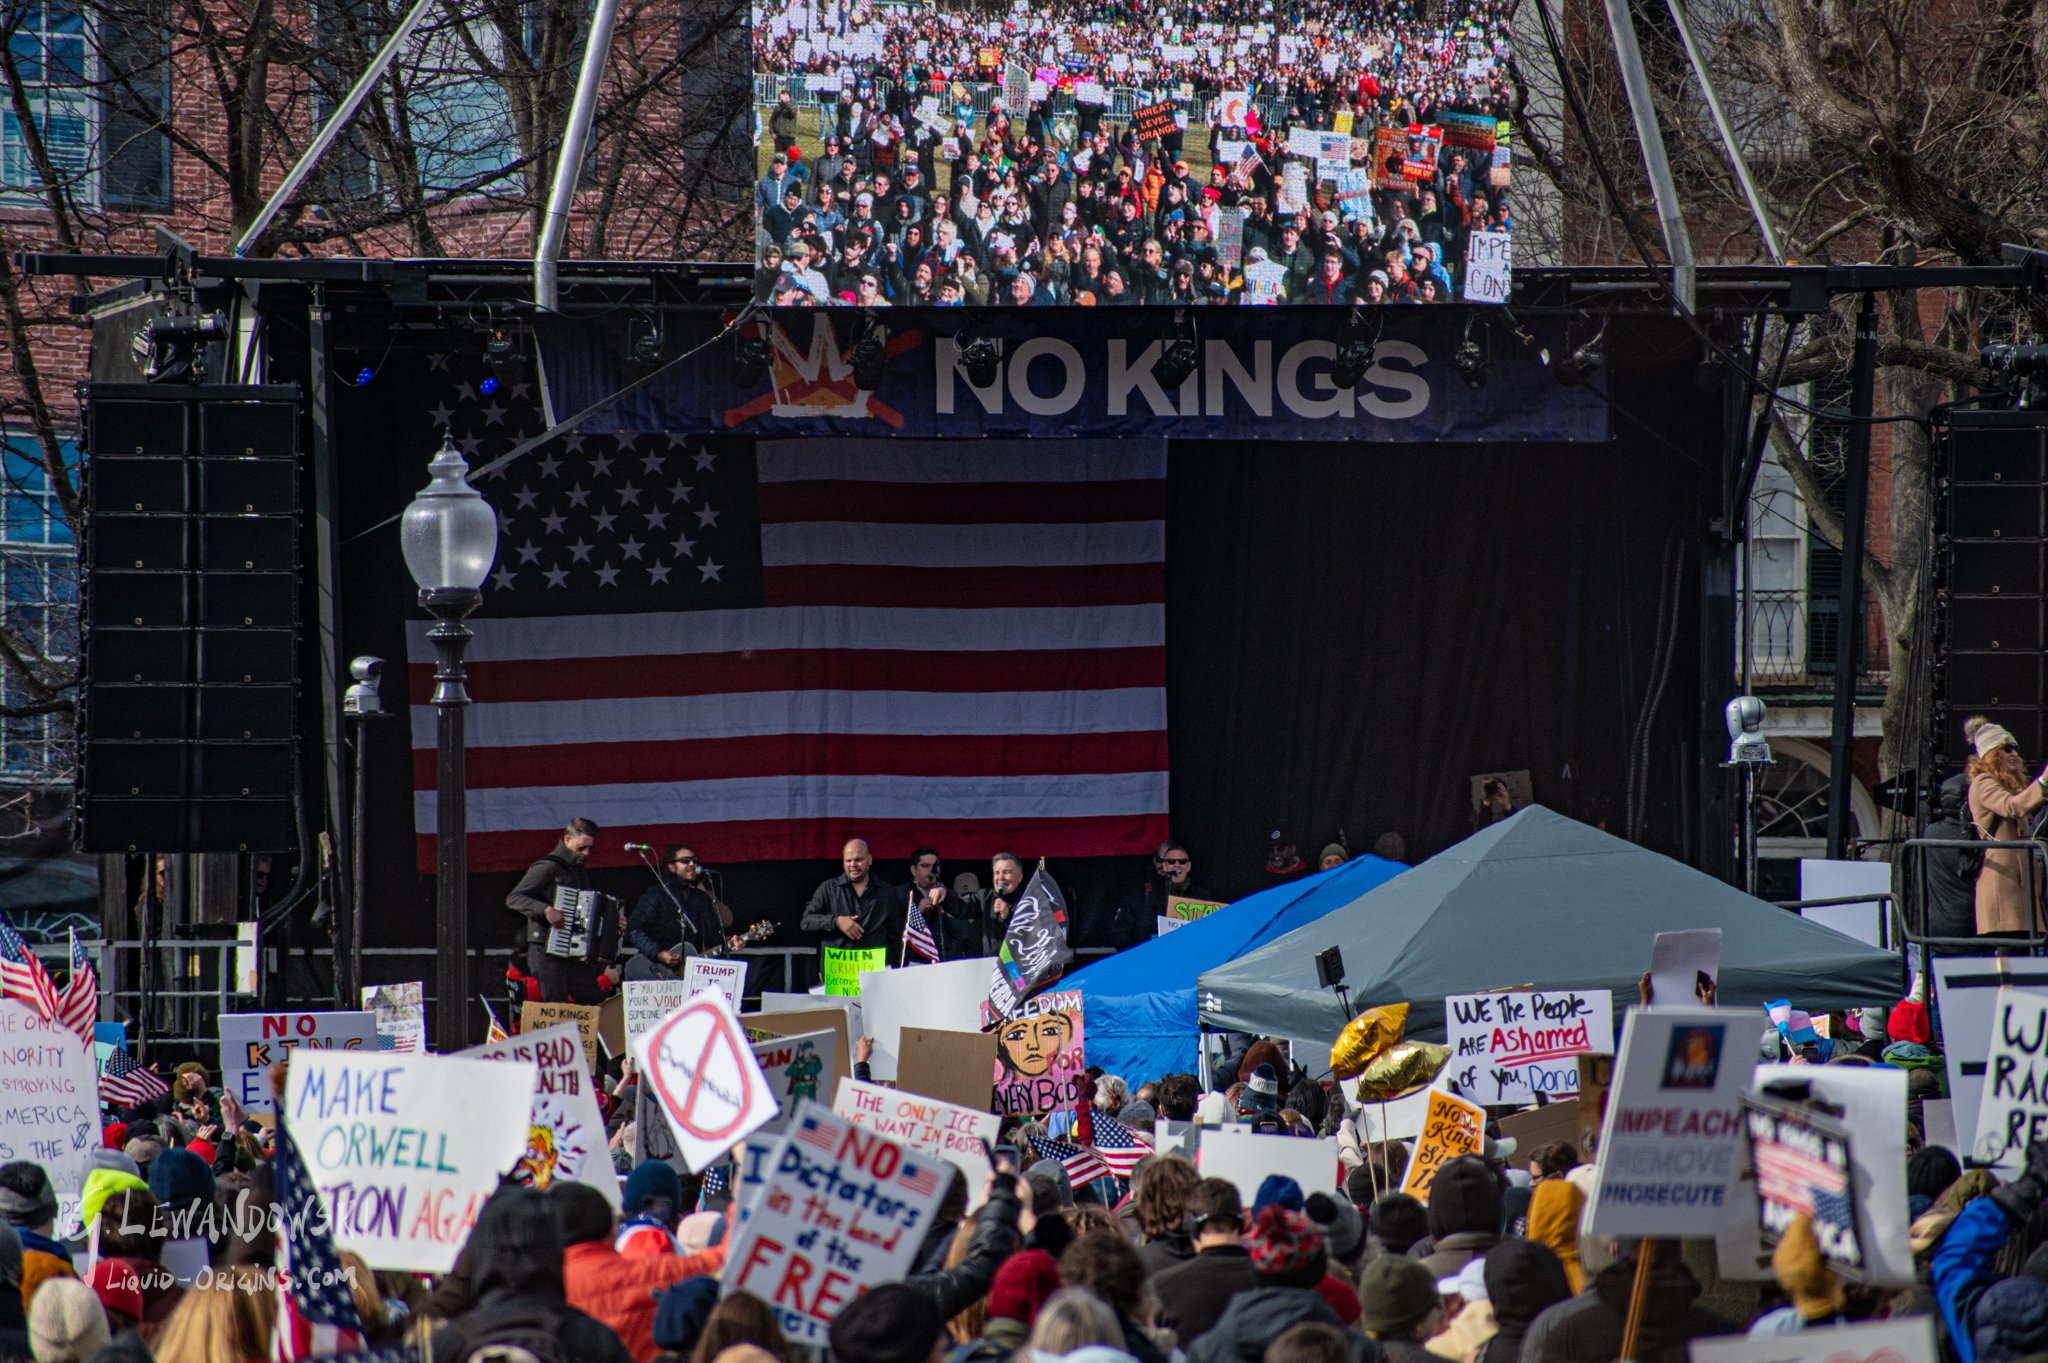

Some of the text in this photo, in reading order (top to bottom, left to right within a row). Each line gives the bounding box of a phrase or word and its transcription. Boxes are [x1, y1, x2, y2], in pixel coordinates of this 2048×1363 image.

[1133, 102, 1172, 119] THREAT
[1140, 115, 1170, 129] LEVEL
[1139, 123, 1178, 142] ORANGE
[1471, 270, 1511, 298] CON
[935, 337, 1430, 419] NO KINGS
[1175, 902, 1221, 921] STA
[827, 949, 873, 962] WHEN
[695, 964, 736, 977] TRUMP
[627, 983, 636, 995] IF
[640, 983, 653, 994] YOU
[628, 996, 649, 1006] YOUR
[540, 1007, 590, 1020] NO KINGS
[628, 1009, 661, 1020] SOMEONE
[1454, 993, 1593, 1026] WE The People
[24, 1014, 69, 1036] ONL
[262, 1015, 316, 1039] NO
[1458, 1017, 1591, 1057] ARE Ashamed
[2003, 1004, 2048, 1057] W
[535, 1037, 575, 1069] BAD
[1045, 1047, 1083, 1075] FOR
[297, 1066, 405, 1119] MAKE
[851, 1088, 979, 1135] THE ONLY ICE
[1612, 1106, 1743, 1137] IMPEACH
[873, 1117, 918, 1138] WANT
[920, 1125, 942, 1144] IN
[1425, 1120, 1480, 1153] Kings
[28, 1139, 64, 1161] THE
[316, 1121, 460, 1174] ORWELL
[837, 1124, 901, 1180] NO
[1611, 1145, 1735, 1177] REMOVE
[777, 1144, 921, 1229] Dictators
[1601, 1182, 1727, 1207] PROSECUTE
[321, 1181, 491, 1243] TION AGA
[801, 1188, 843, 1233] the
[796, 1228, 865, 1272] of the
[737, 1235, 872, 1322] FRE
